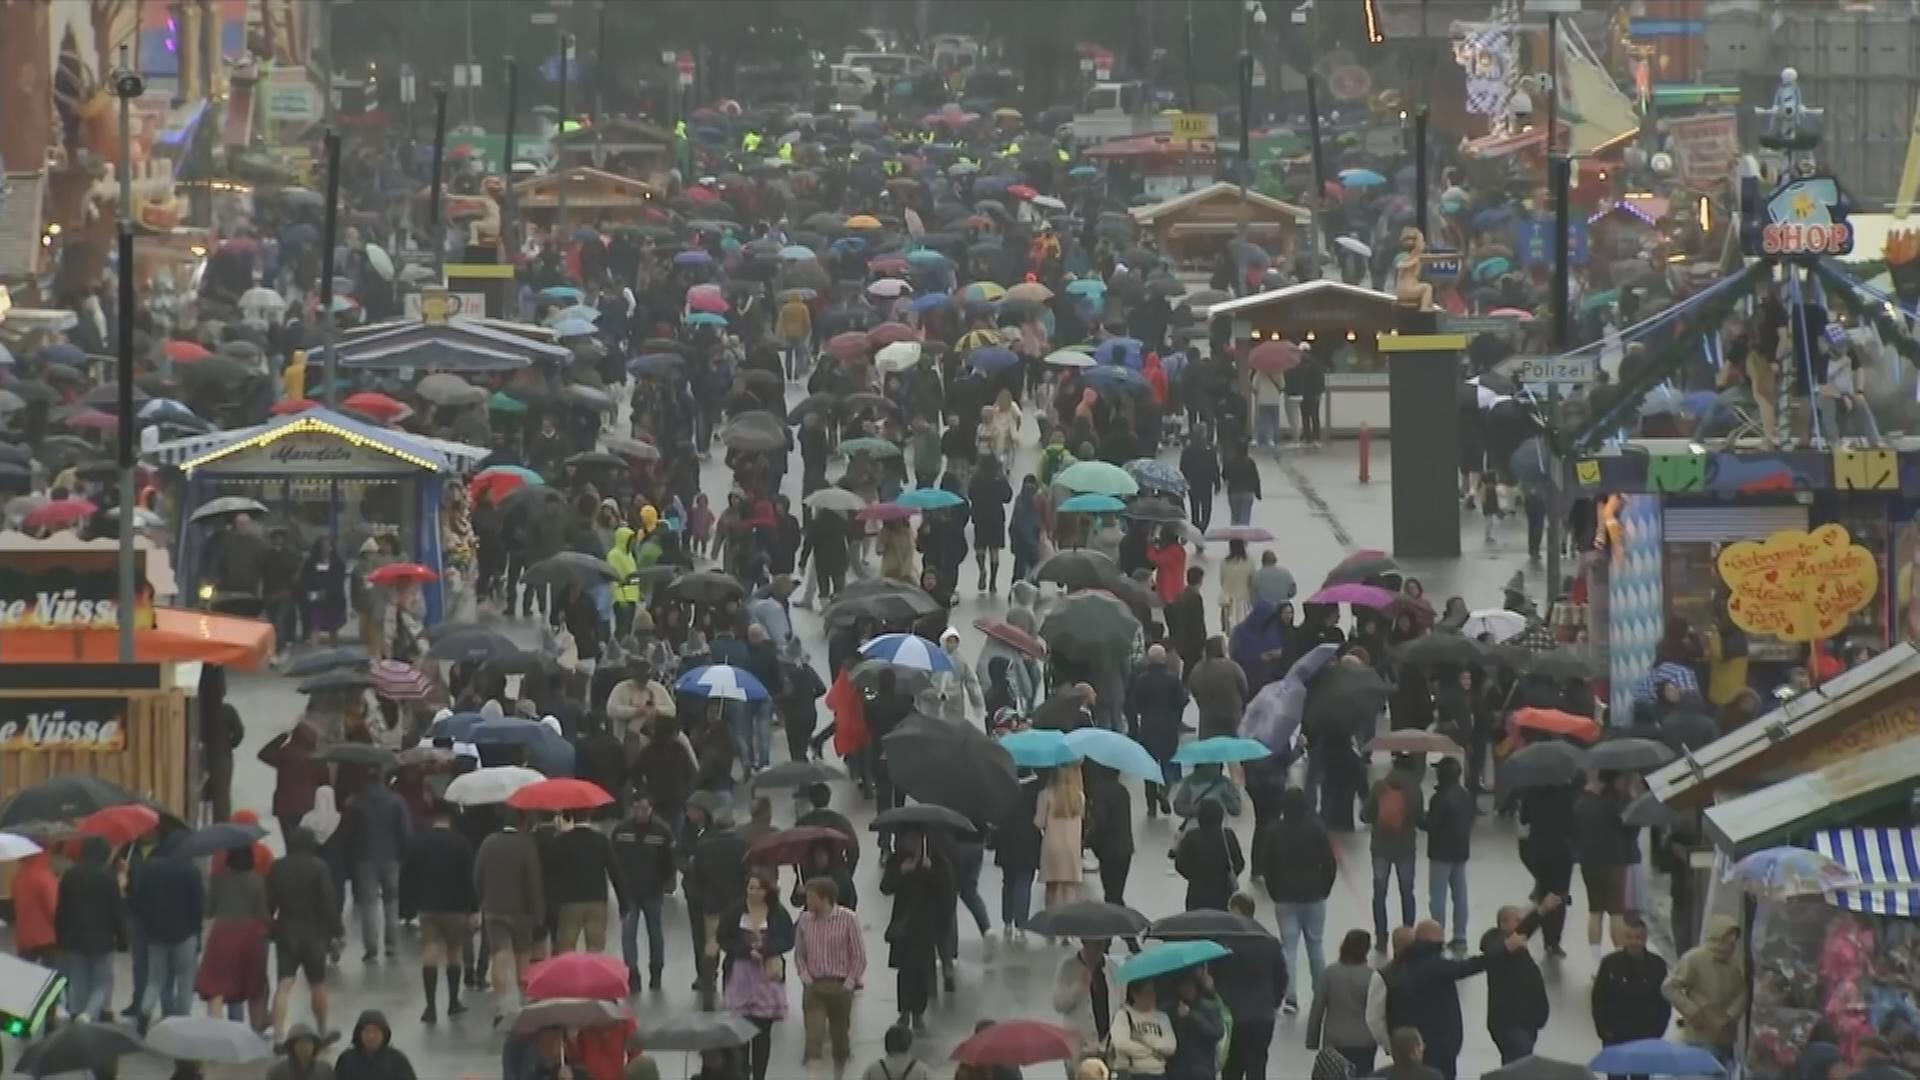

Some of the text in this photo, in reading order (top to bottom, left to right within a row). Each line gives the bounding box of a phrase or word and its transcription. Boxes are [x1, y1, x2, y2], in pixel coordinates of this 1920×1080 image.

[1763, 224, 1848, 254] SHOP
[1523, 361, 1585, 378] Polizei
[23, 711, 120, 746] Nüsse
